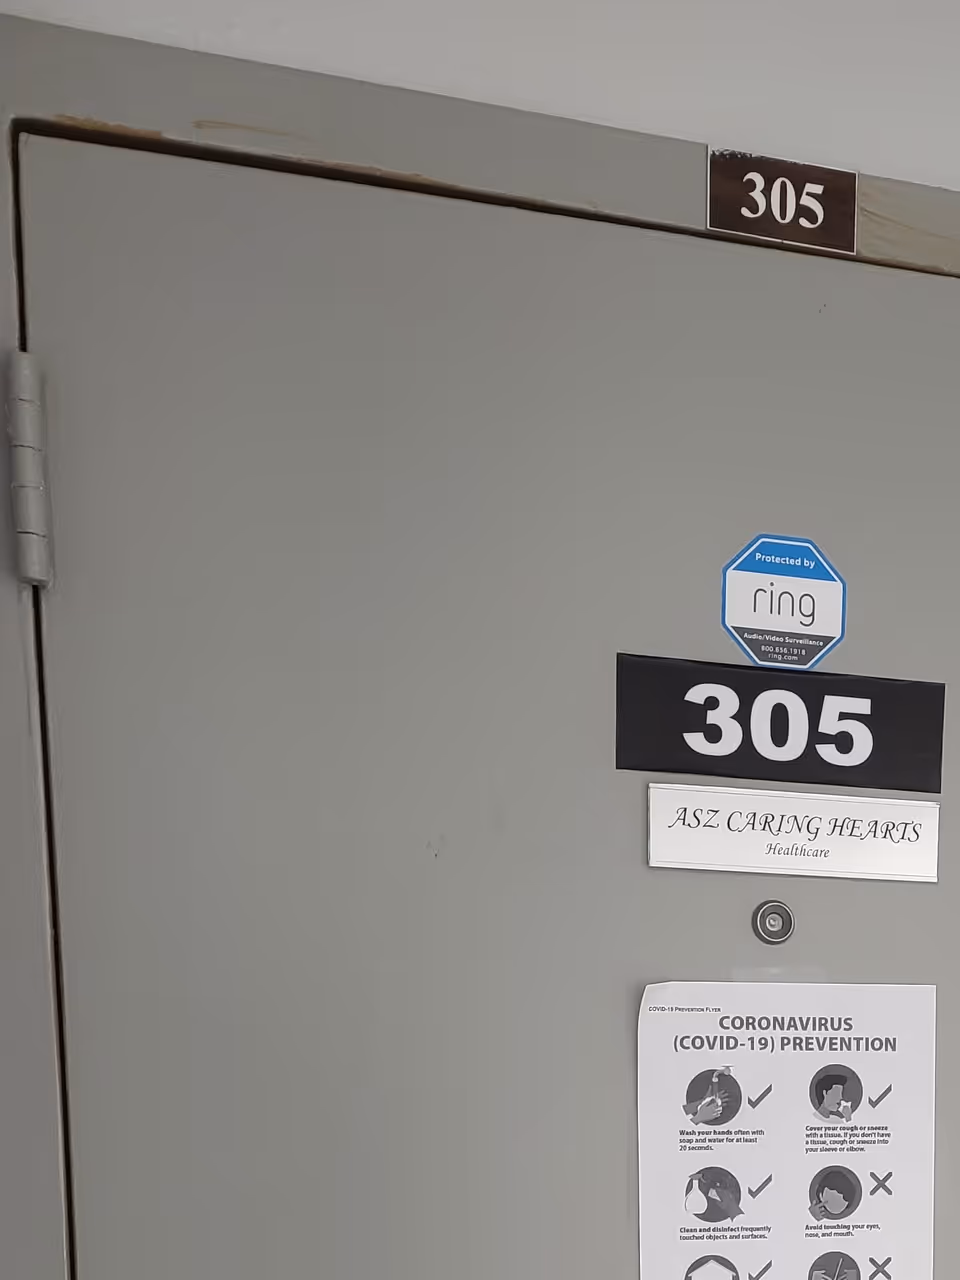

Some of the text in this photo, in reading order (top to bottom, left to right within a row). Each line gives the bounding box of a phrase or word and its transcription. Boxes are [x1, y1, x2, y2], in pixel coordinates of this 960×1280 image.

[740, 171, 825, 229] 305
[755, 552, 816, 569] Protected by
[753, 581, 816, 627] ring
[743, 632, 824, 647] Audio/Video Surveillance
[682, 682, 874, 767] 305
[668, 807, 922, 844] ASZ CARING HEARTS
[765, 842, 830, 859] Healthcare
[718, 1015, 853, 1032] CORONAVIRUS
[673, 1035, 897, 1053] (COVID-19) PREVENTION
